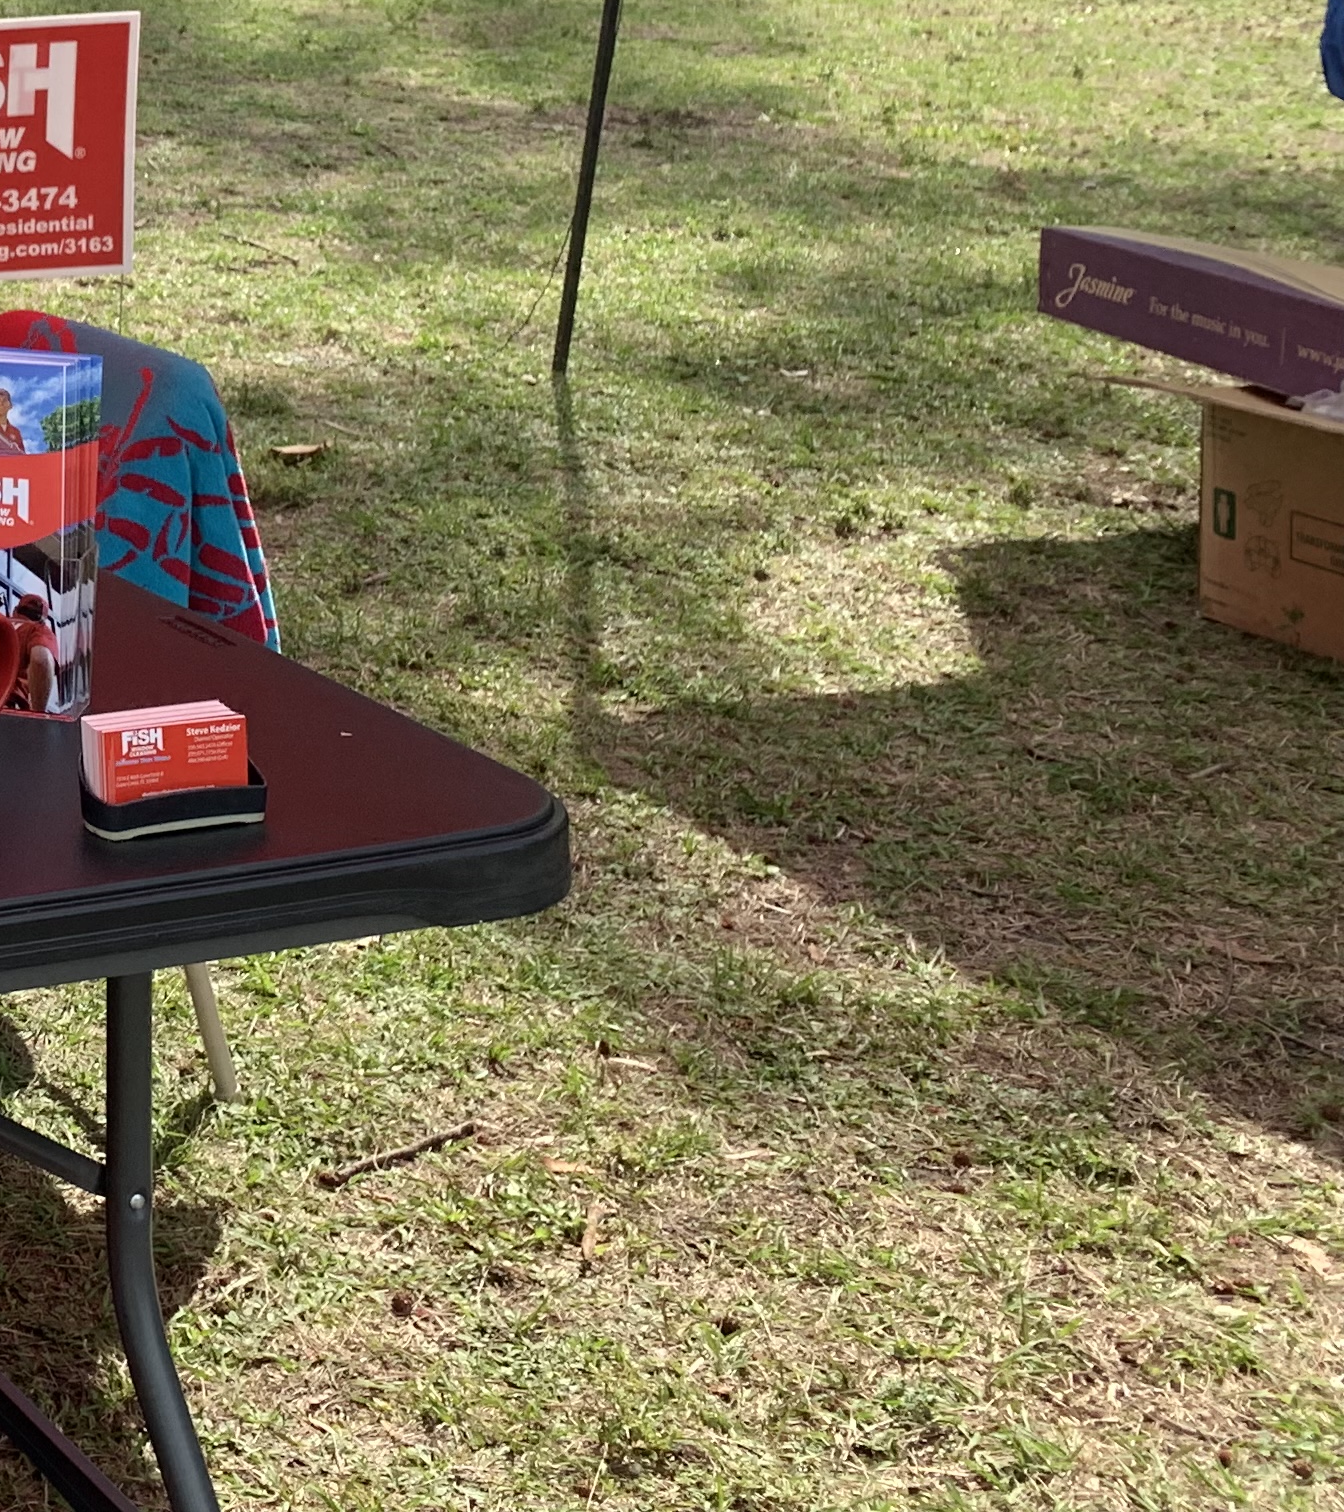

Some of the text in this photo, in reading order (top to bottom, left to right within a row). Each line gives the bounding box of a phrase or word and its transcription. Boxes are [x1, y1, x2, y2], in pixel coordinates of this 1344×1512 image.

[1055, 263, 1136, 309] Jasmine
[1149, 296, 1170, 316] For
[1170, 300, 1190, 322] the
[1191, 308, 1227, 336] music
[1229, 317, 1242, 338] in
[185, 727, 209, 737] Steve
[210, 723, 241, 735] Kedzior
